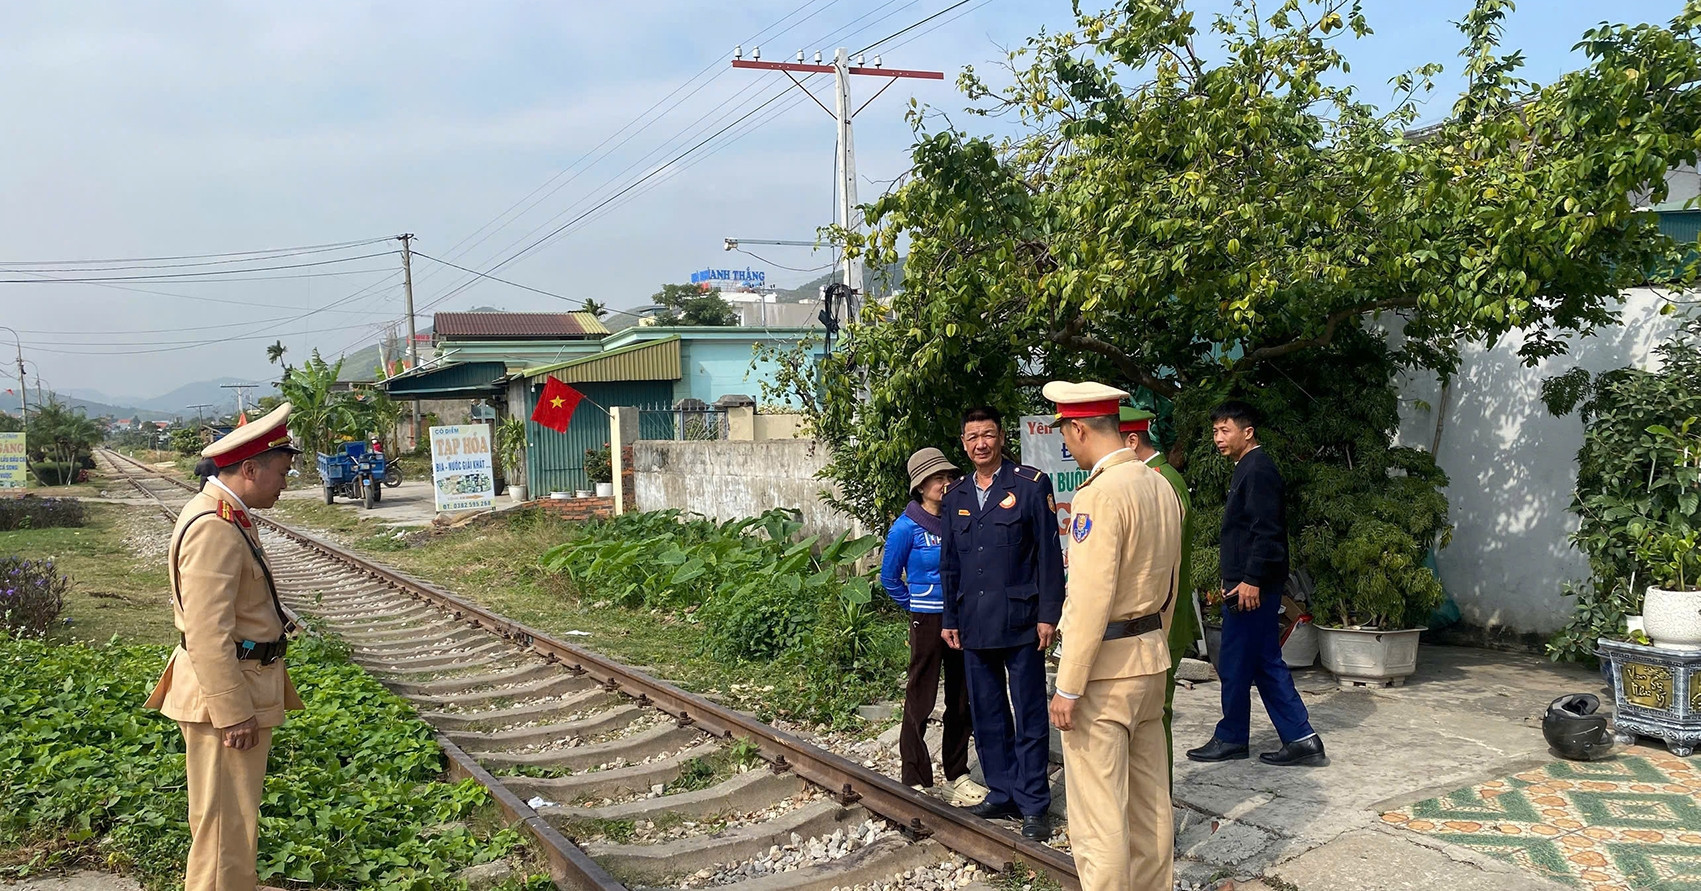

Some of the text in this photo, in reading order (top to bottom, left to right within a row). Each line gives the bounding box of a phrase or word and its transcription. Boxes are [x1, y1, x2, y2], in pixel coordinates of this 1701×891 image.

[709, 269, 730, 280] ANH
[732, 266, 765, 281] THẮNG
[1027, 421, 1053, 435] Yên
[435, 437, 460, 461] TẠP
[436, 462, 445, 472] BIA
[473, 458, 485, 469] KHÁT
